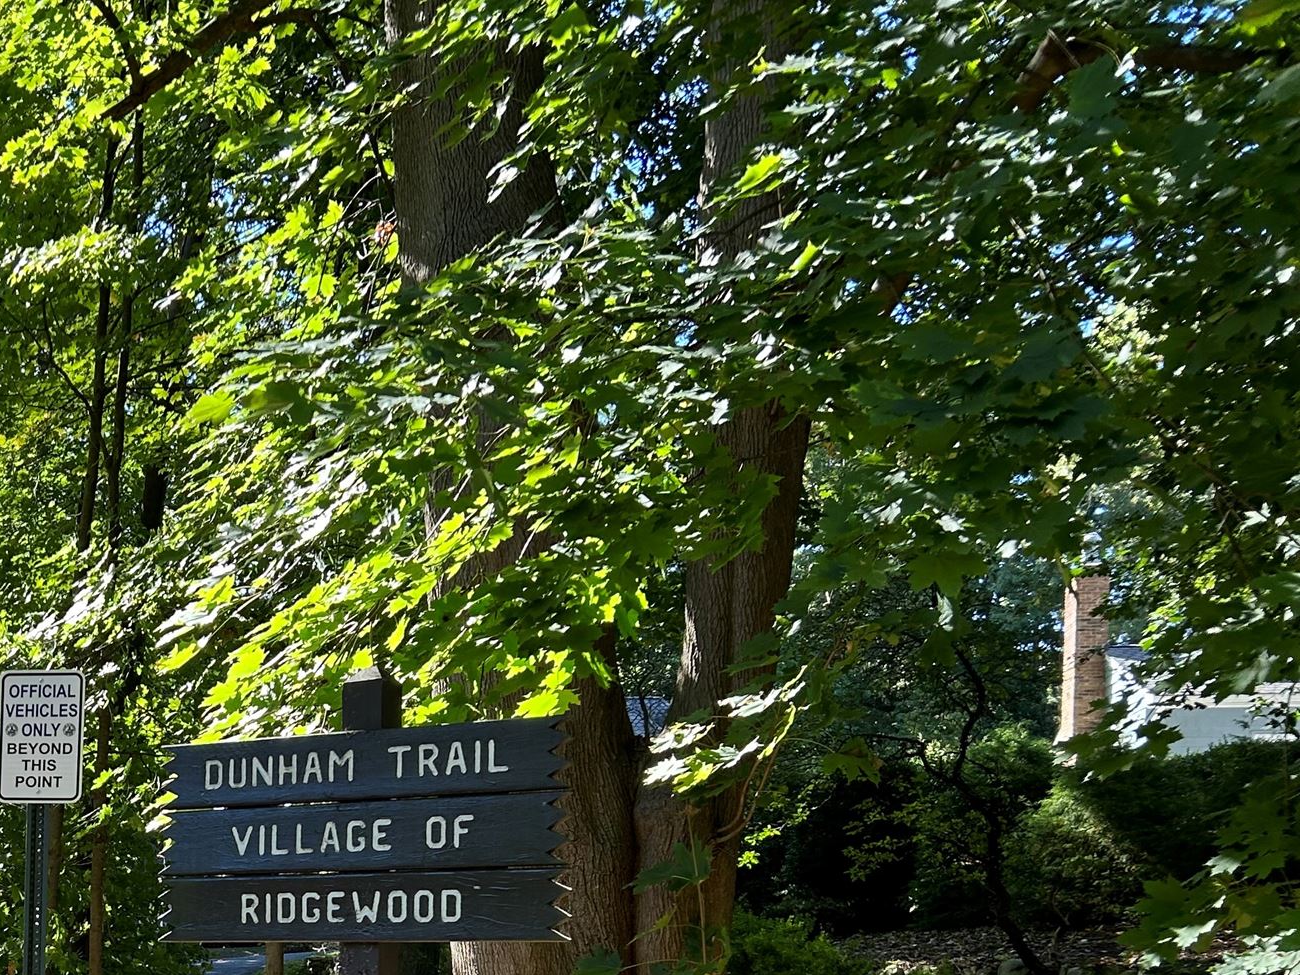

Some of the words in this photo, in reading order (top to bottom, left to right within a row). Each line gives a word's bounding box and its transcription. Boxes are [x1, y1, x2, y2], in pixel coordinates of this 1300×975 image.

[9, 684, 76, 698] OFFICIAL
[6, 704, 78, 717] VEHICLES
[21, 723, 61, 737] ONLY
[7, 743, 73, 755] BEYOND
[21, 759, 57, 771] THIS
[204, 749, 354, 790] DUNHAM
[387, 739, 509, 778] TRAIL
[15, 776, 63, 788] POINT
[232, 819, 392, 856] VILLAGE
[425, 814, 475, 849] OF
[240, 889, 463, 924] RIDGEWOOD
